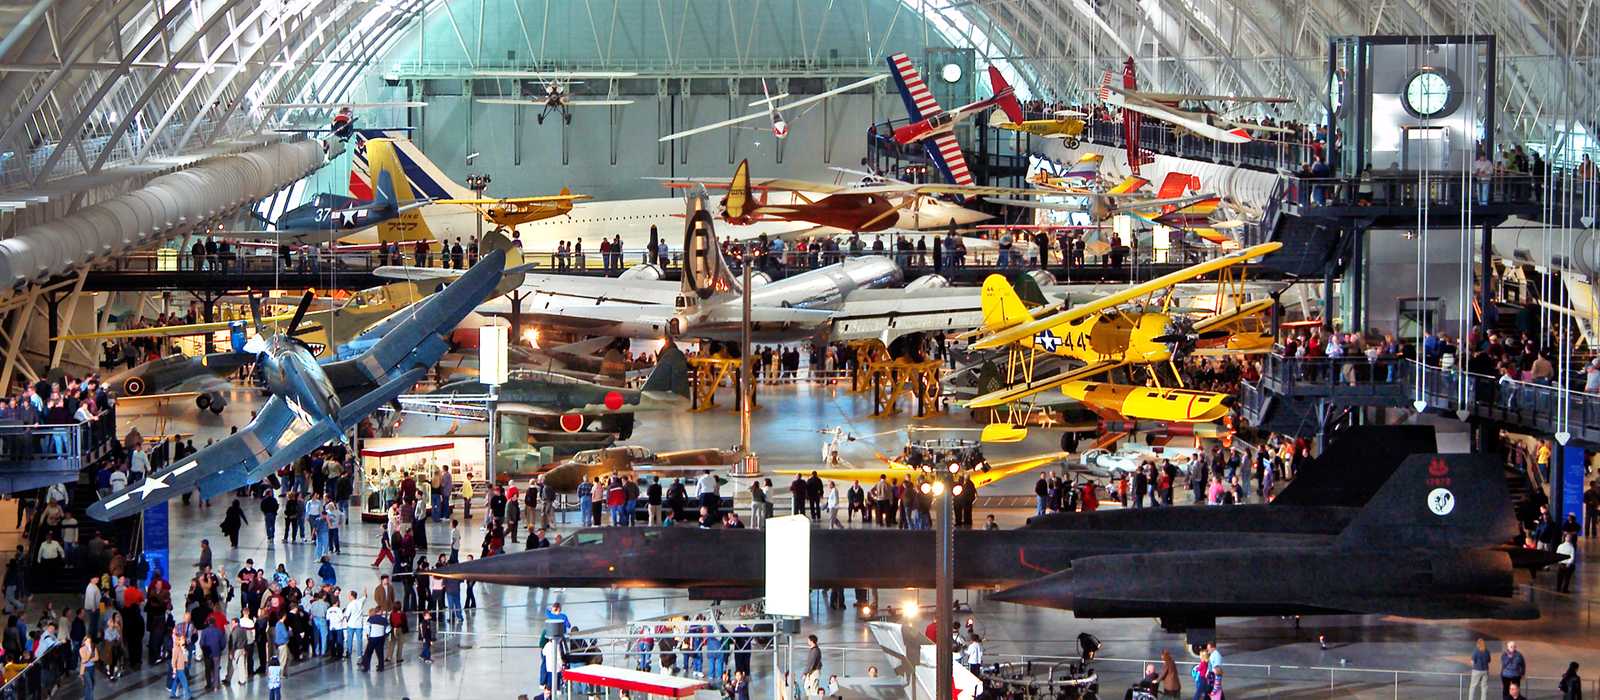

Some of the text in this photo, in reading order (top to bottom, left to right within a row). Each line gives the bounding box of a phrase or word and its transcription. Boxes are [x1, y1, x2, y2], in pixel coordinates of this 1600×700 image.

[314, 208, 331, 222] 37
[387, 222, 418, 232] 707
[1065, 332, 1086, 352] 44
